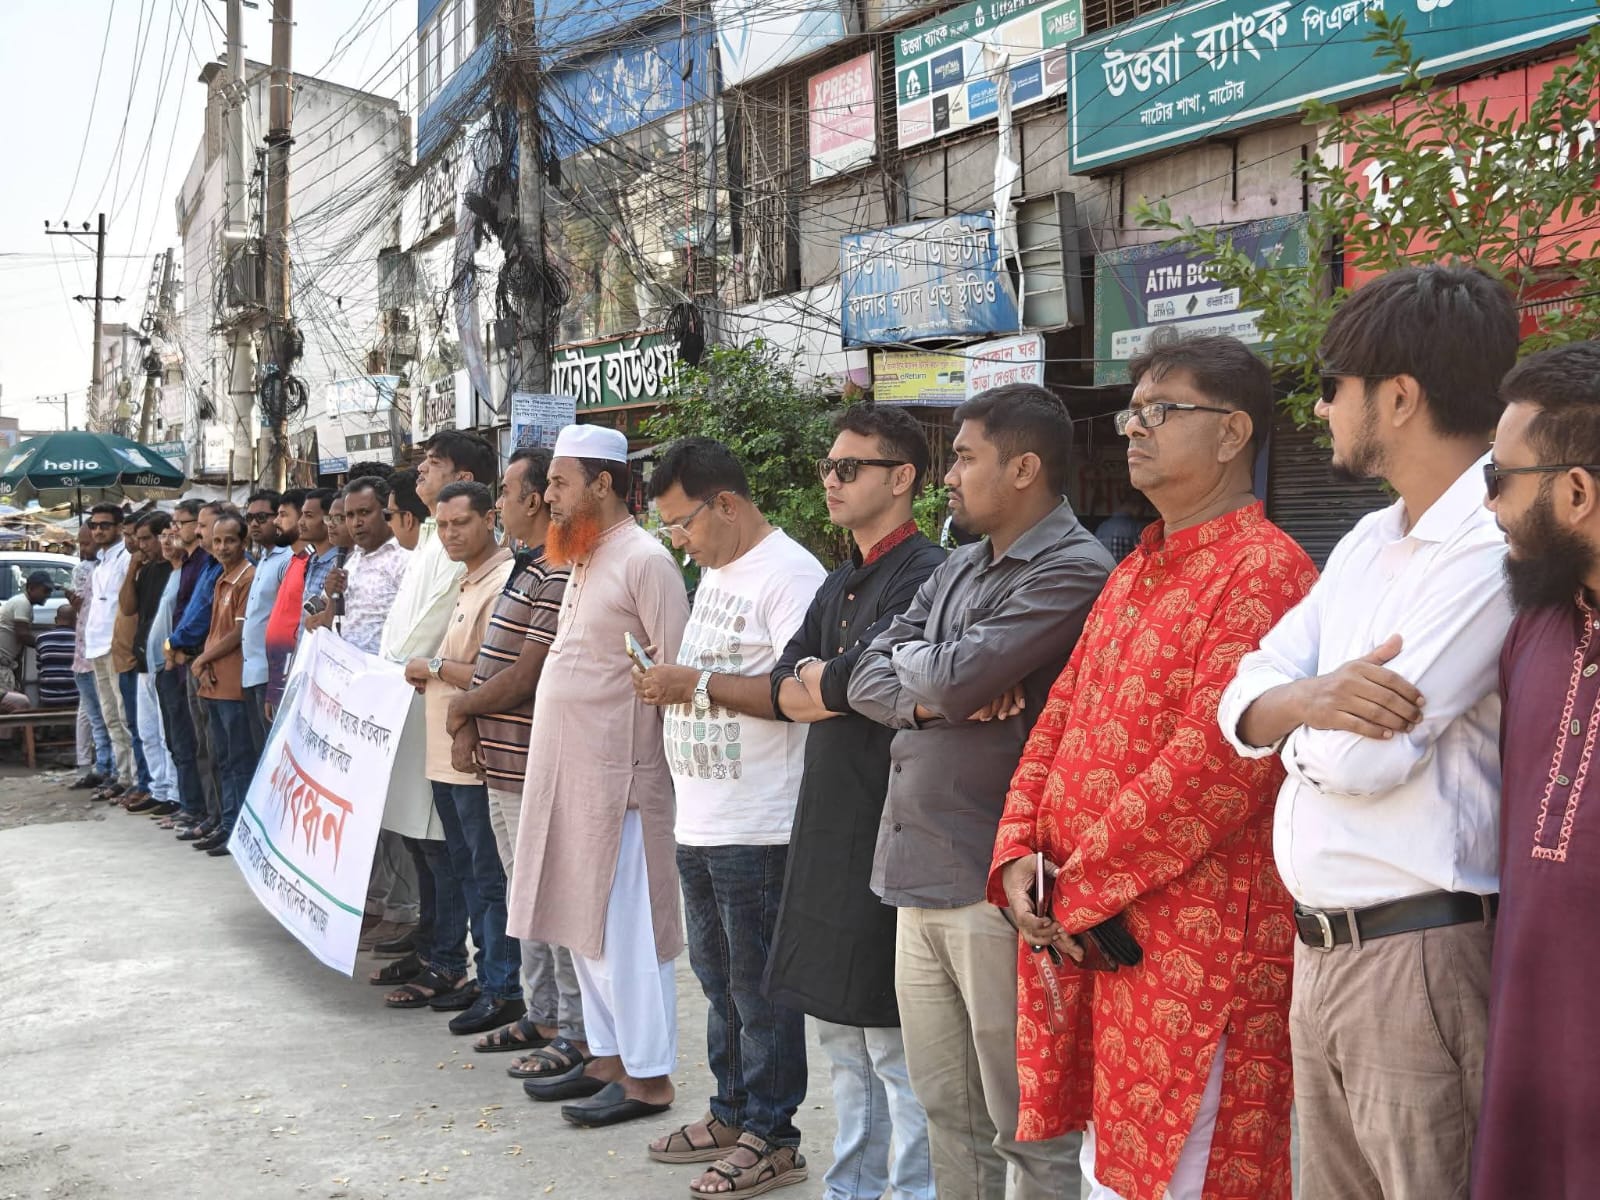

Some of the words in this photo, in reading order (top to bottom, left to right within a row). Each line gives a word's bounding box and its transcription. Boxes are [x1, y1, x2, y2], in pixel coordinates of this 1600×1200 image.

[1054, 9, 1077, 27] NEC
[901, 35, 923, 56] উত্তরা
[923, 25, 948, 48] ব্যাংক
[1101, 32, 1186, 97] উত্তরা
[1191, 1, 1292, 71] ব্যাংক
[814, 67, 862, 104] XPRESS
[828, 85, 870, 123] MONEY
[1140, 102, 1173, 128] নাটোর
[1208, 80, 1245, 105] নাটোর
[846, 239, 875, 281] নিউ
[1145, 264, 1182, 294] ATM
[847, 292, 888, 320] কালার
[890, 286, 923, 315] ল্যাব
[973, 347, 1014, 369] দোকান
[1017, 341, 1037, 357] ঘর
[550, 348, 602, 405] াটোর
[900, 372, 927, 381] eReturn
[1020, 364, 1037, 382] হবে
[44, 459, 99, 471] helio
[135, 474, 161, 485] helio
[1040, 957, 1062, 1011] HONDA
